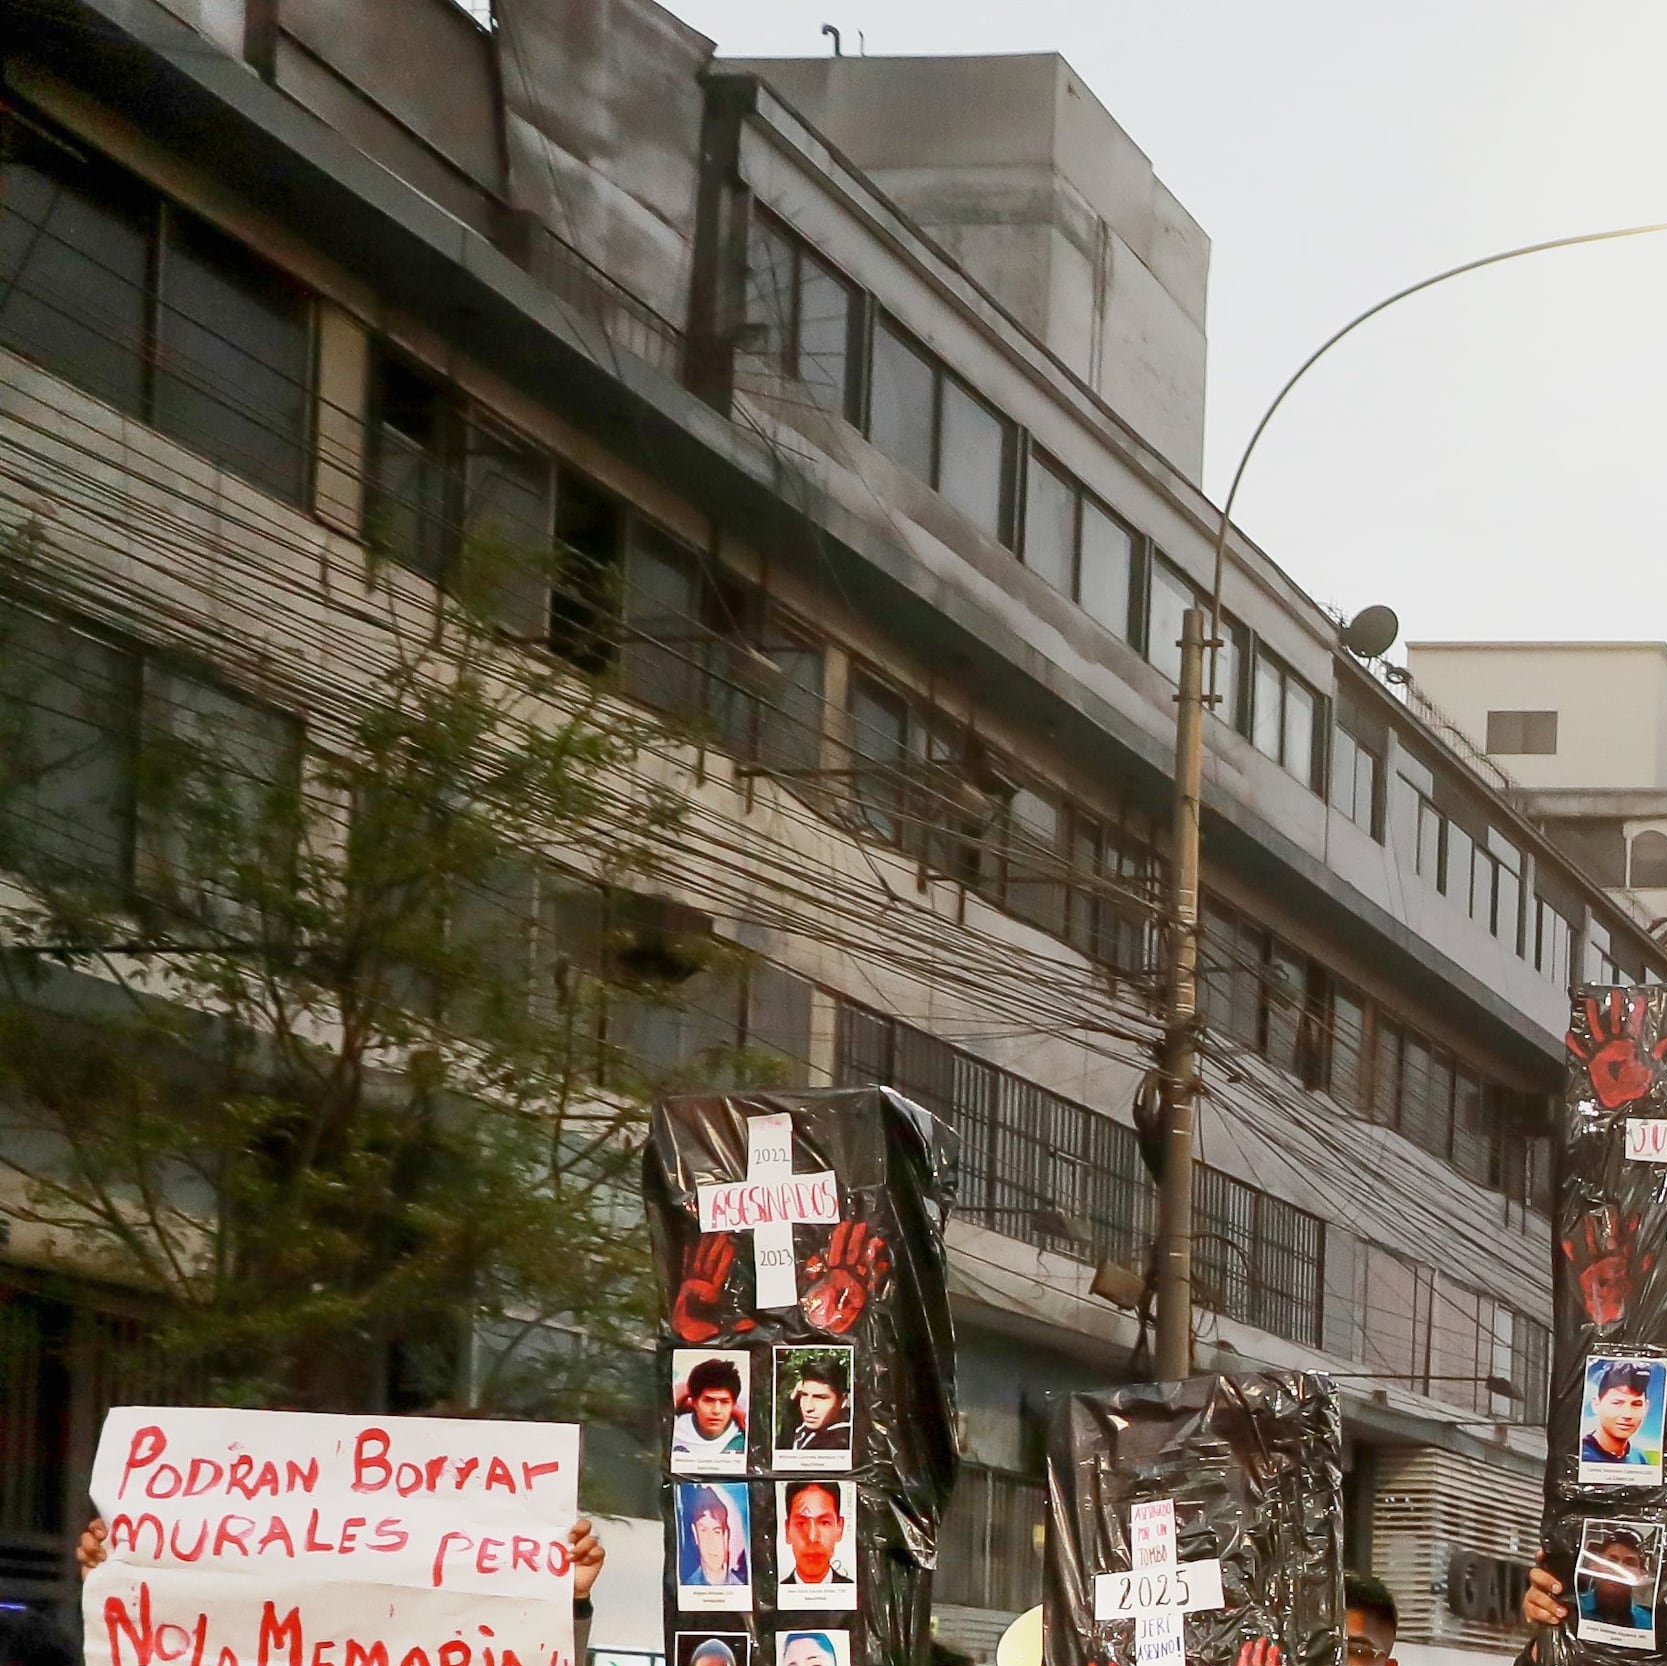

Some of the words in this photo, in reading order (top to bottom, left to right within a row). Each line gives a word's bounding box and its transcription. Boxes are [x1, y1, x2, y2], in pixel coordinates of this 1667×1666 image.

[754, 1148, 790, 1165] 2022
[711, 1179, 839, 1229] ASESINADOS
[760, 1248, 794, 1266] 2023
[111, 1508, 409, 1562] MURALES
[1118, 1570, 1190, 1610] 2025
